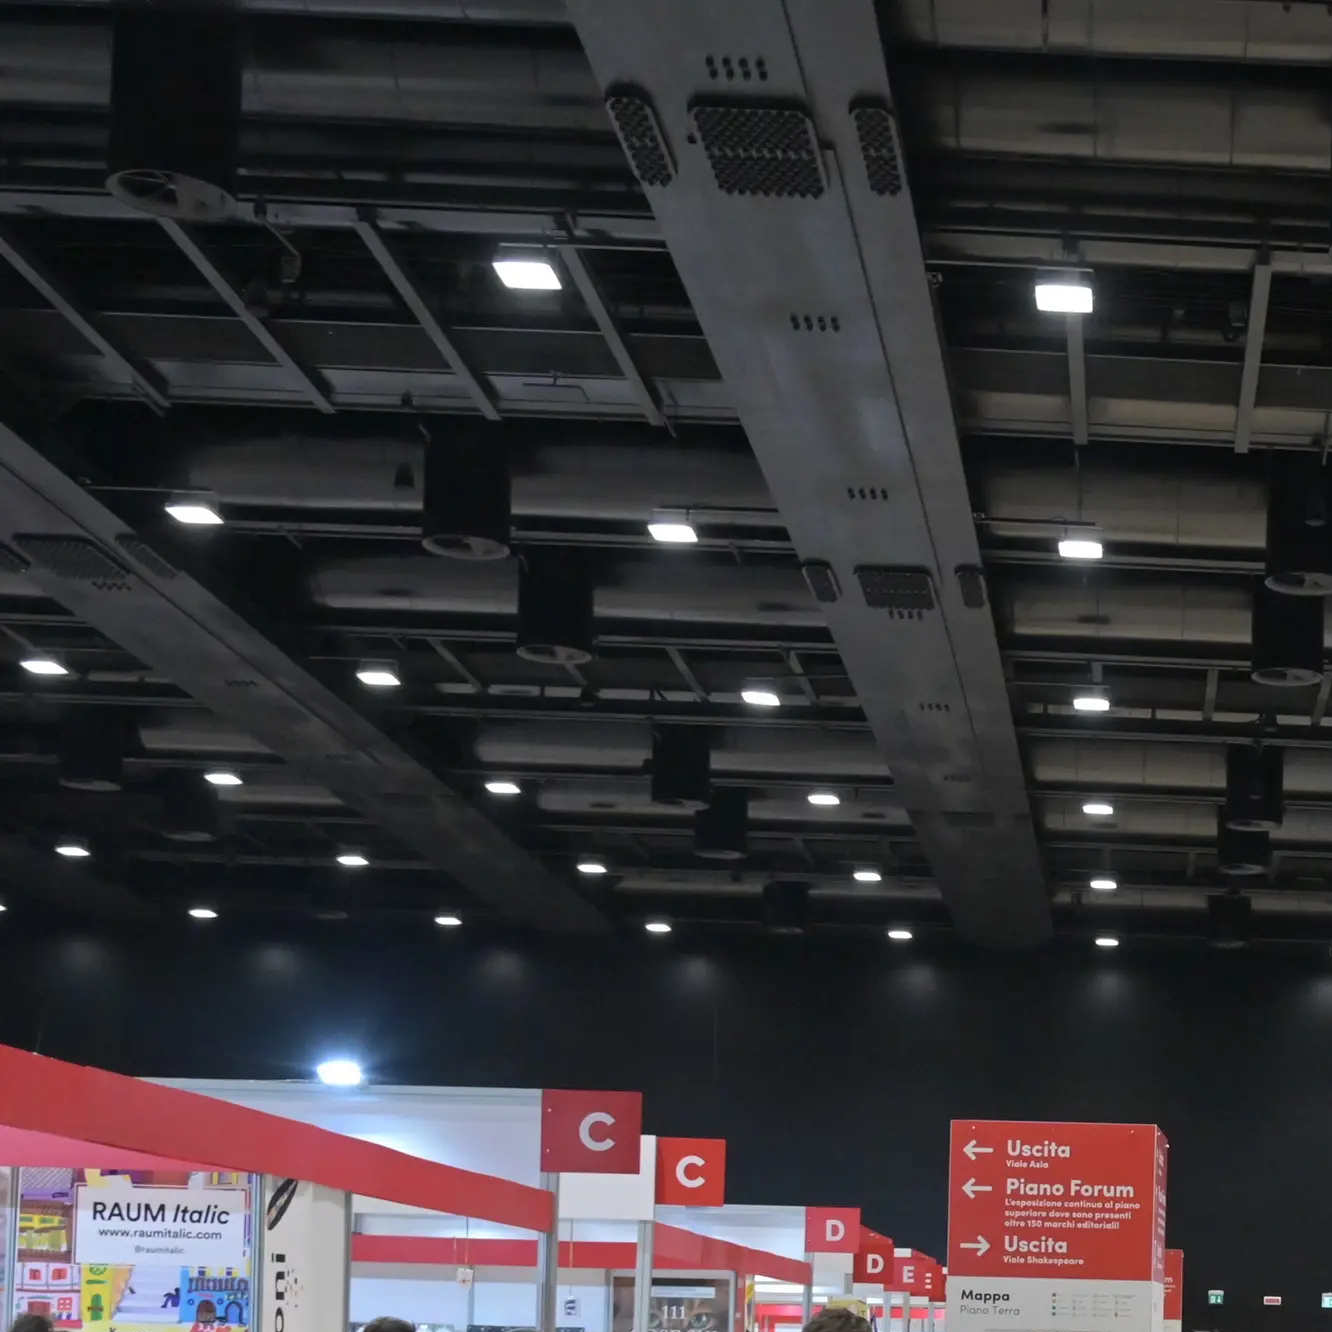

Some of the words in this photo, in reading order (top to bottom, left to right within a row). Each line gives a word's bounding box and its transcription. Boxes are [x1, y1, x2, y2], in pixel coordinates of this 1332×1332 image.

[579, 1112, 616, 1152] C
[1007, 1139, 1071, 1158] Uscita
[676, 1154, 706, 1189] C
[1006, 1160, 1028, 1169] Viale
[1029, 1160, 1049, 1169] Asia
[1006, 1178, 1065, 1196] Piano
[1070, 1179, 1135, 1198] Forum
[93, 1201, 166, 1222] RAUM
[172, 1204, 230, 1225] Italic
[1064, 1199, 1103, 1209] continua
[1104, 1200, 1114, 1209] al
[1115, 1201, 1141, 1211] piano
[1004, 1208, 1047, 1219] superiore
[1048, 1209, 1070, 1218] dove
[1095, 1210, 1132, 1221] presenti
[825, 1219, 845, 1242] D
[1004, 1219, 1026, 1228] oltre
[1027, 1219, 1043, 1228] 150
[1044, 1220, 1075, 1229] marchi
[98, 1228, 223, 1241] www.raumitalic.com
[1004, 1235, 1068, 1254] Uscita
[866, 1253, 885, 1274] D
[1003, 1255, 1026, 1264] Viale
[1027, 1255, 1085, 1267] Shakespeare
[902, 1265, 915, 1283] E
[961, 1289, 1010, 1304] Mappa
[661, 1305, 687, 1320] 111
[960, 1304, 990, 1316] Piano
[992, 1305, 1020, 1316] Terra
